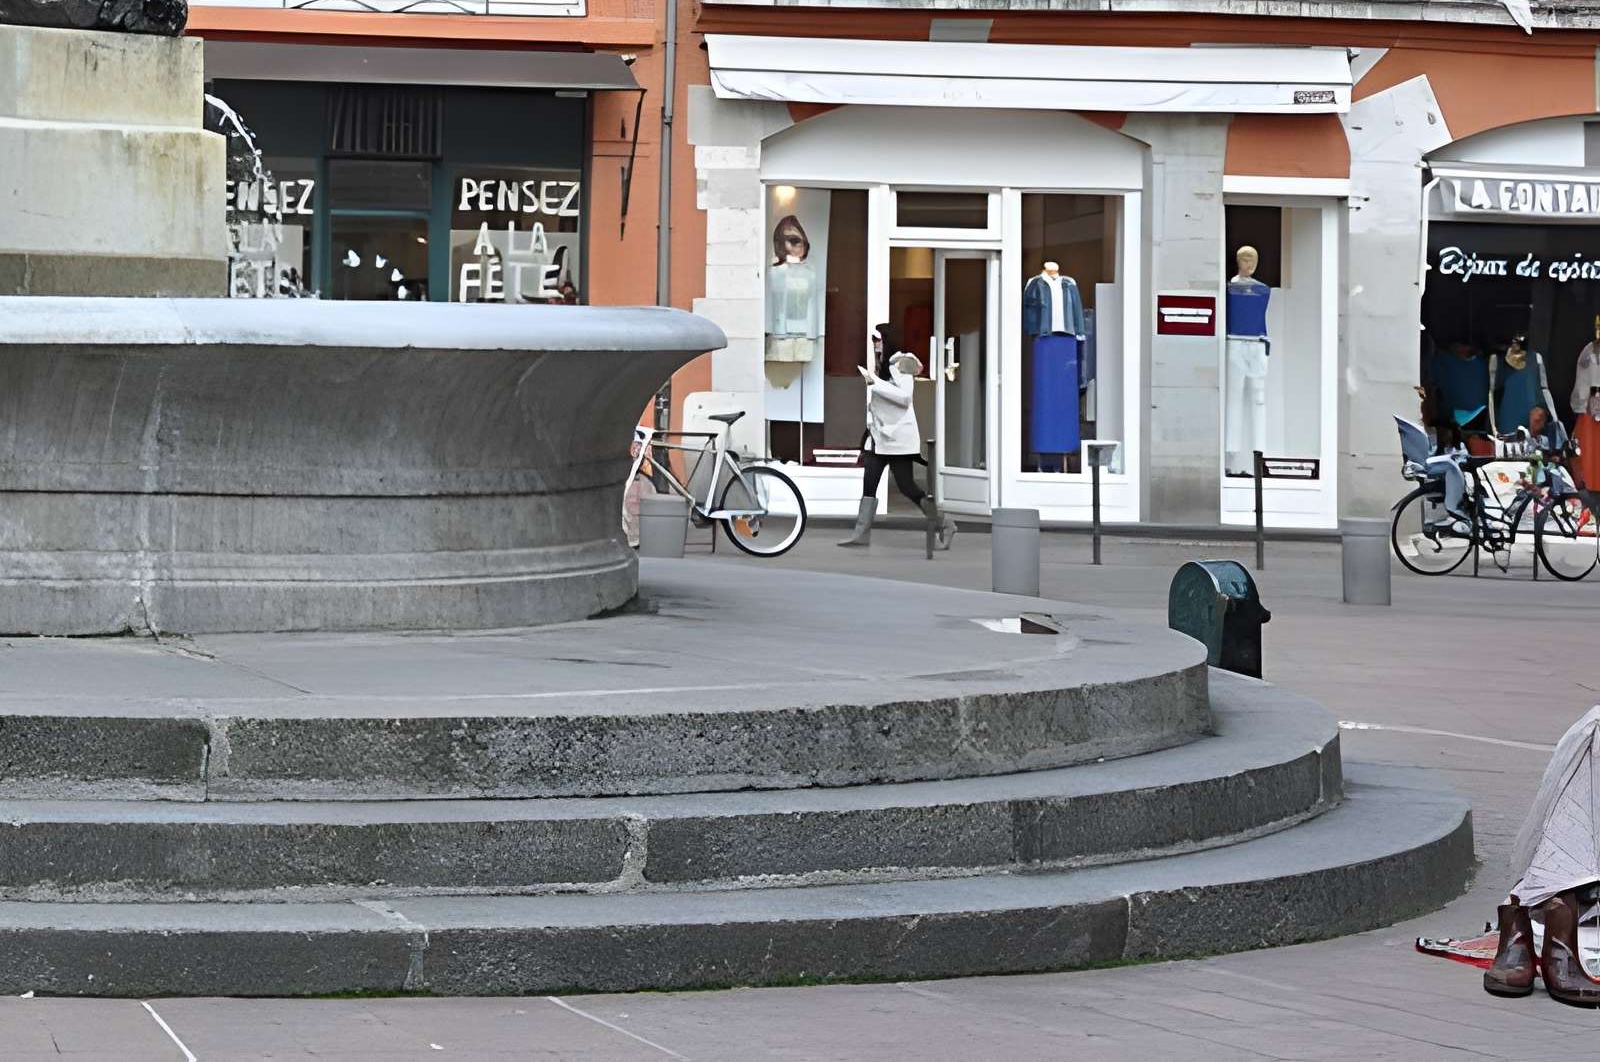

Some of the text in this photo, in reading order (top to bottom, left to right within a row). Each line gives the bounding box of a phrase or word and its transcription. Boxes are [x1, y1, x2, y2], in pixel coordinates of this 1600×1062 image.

[226, 178, 315, 214] ENSEZ
[458, 177, 580, 217] PENSEZ
[1451, 179, 1600, 214] LA FONTAI
[508, 220, 548, 255] LA
